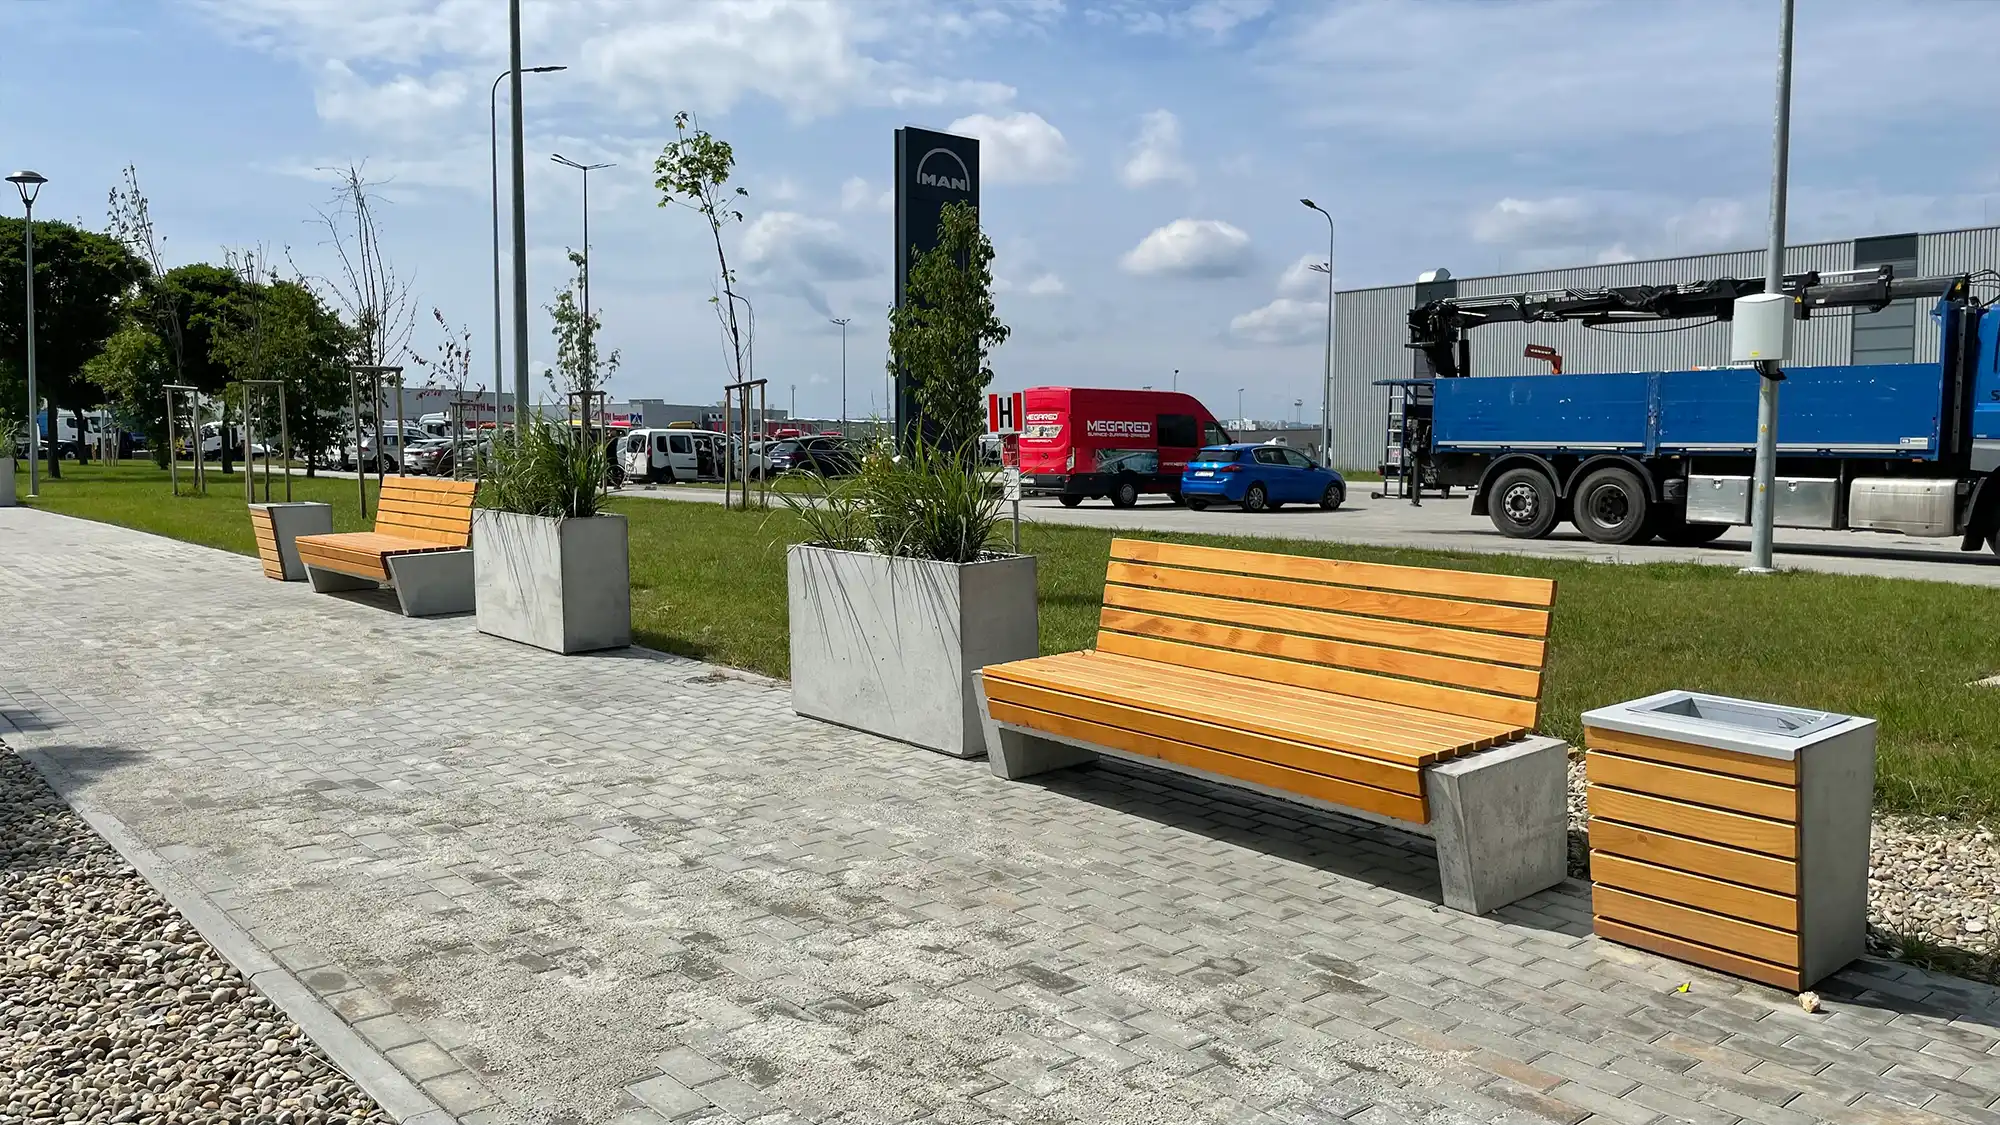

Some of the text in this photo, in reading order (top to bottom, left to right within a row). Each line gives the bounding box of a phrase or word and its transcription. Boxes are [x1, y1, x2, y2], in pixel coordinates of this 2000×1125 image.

[921, 172, 966, 191] MAN
[999, 397, 1013, 428] H
[1087, 420, 1151, 432] MEGARED
